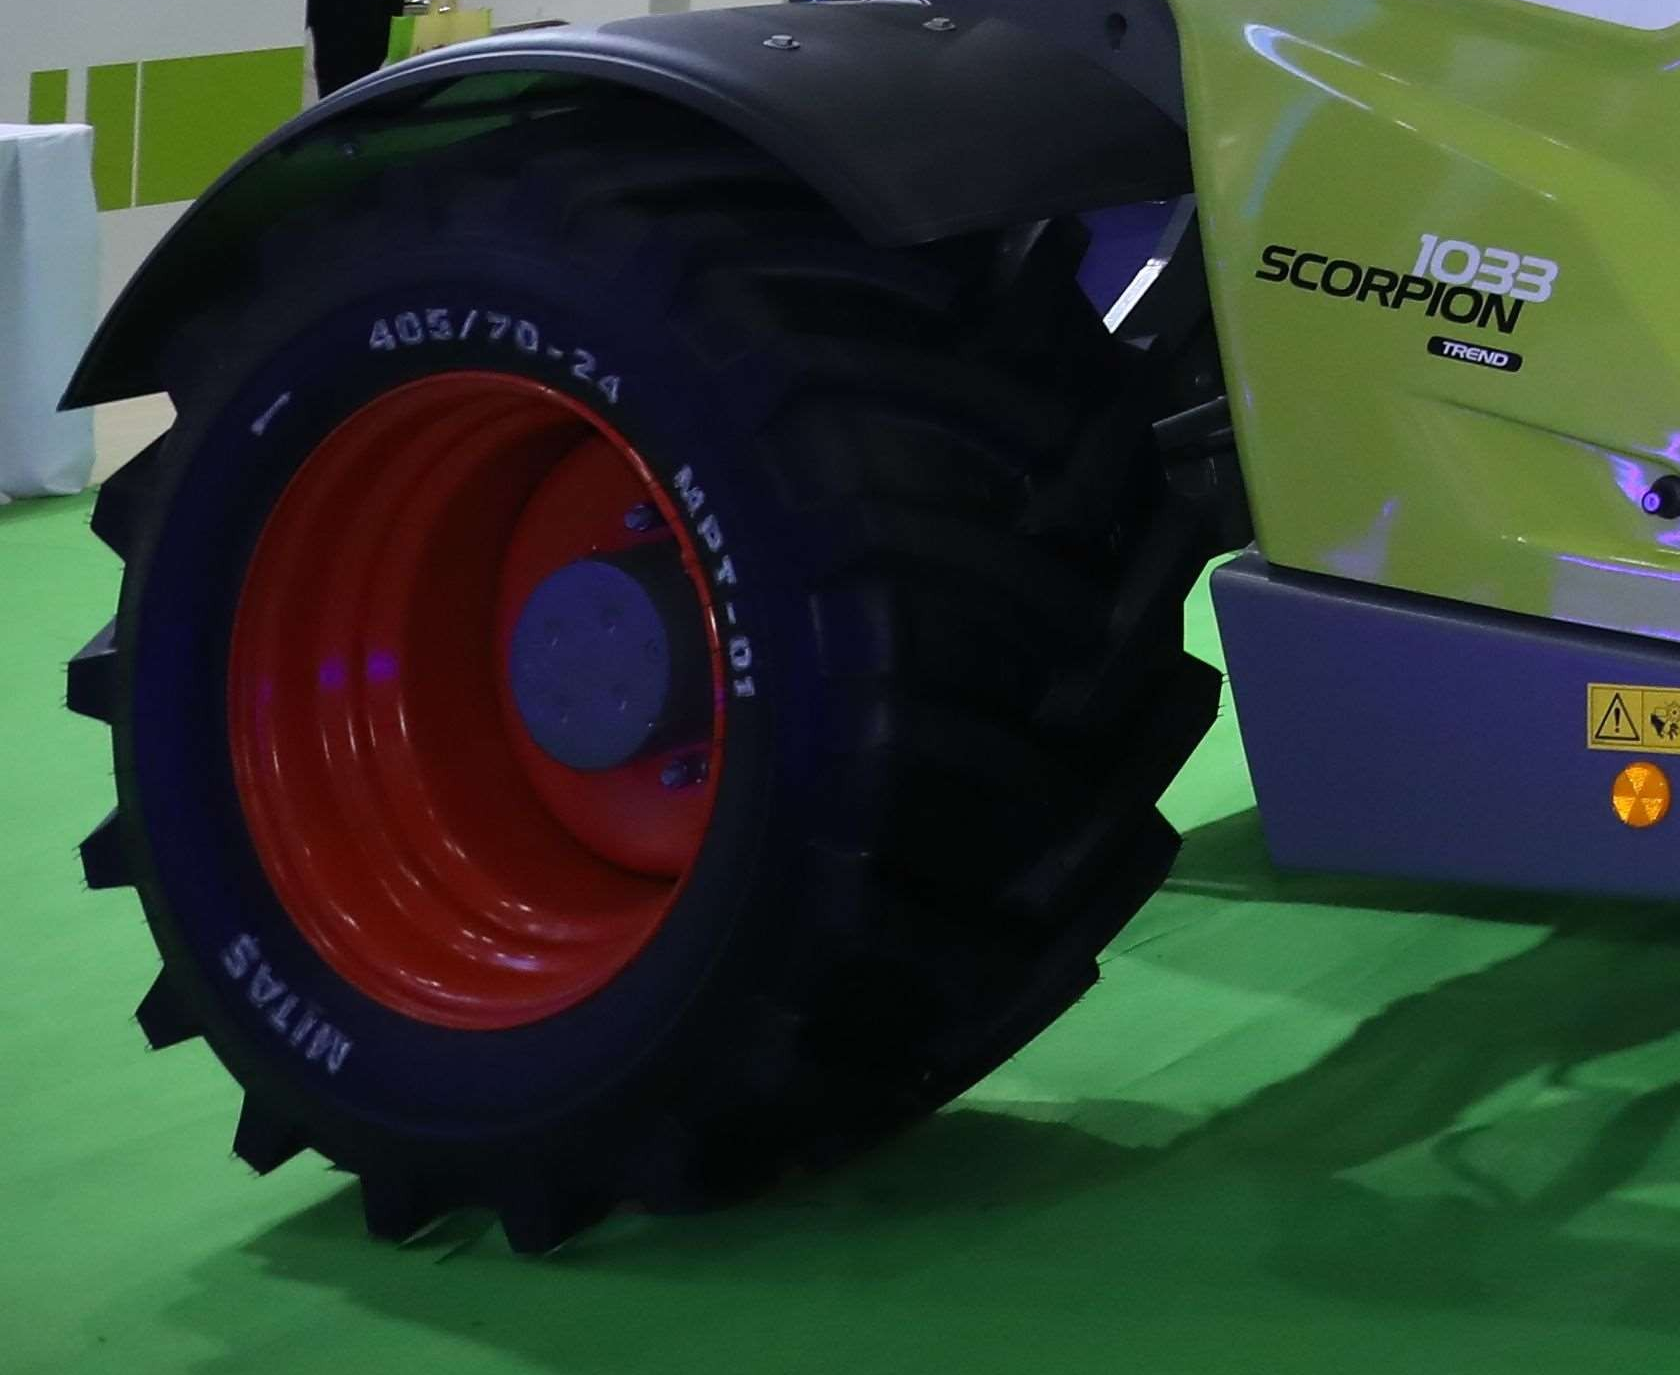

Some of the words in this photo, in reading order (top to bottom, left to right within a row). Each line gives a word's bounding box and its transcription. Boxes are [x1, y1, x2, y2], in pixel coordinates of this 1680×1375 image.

[1255, 245, 1525, 334] SCORPION
[1412, 234, 1559, 302] 1033
[369, 308, 621, 405] 405/70-24
[1442, 341, 1508, 367] TREND
[223, 933, 351, 1073] MITAS
